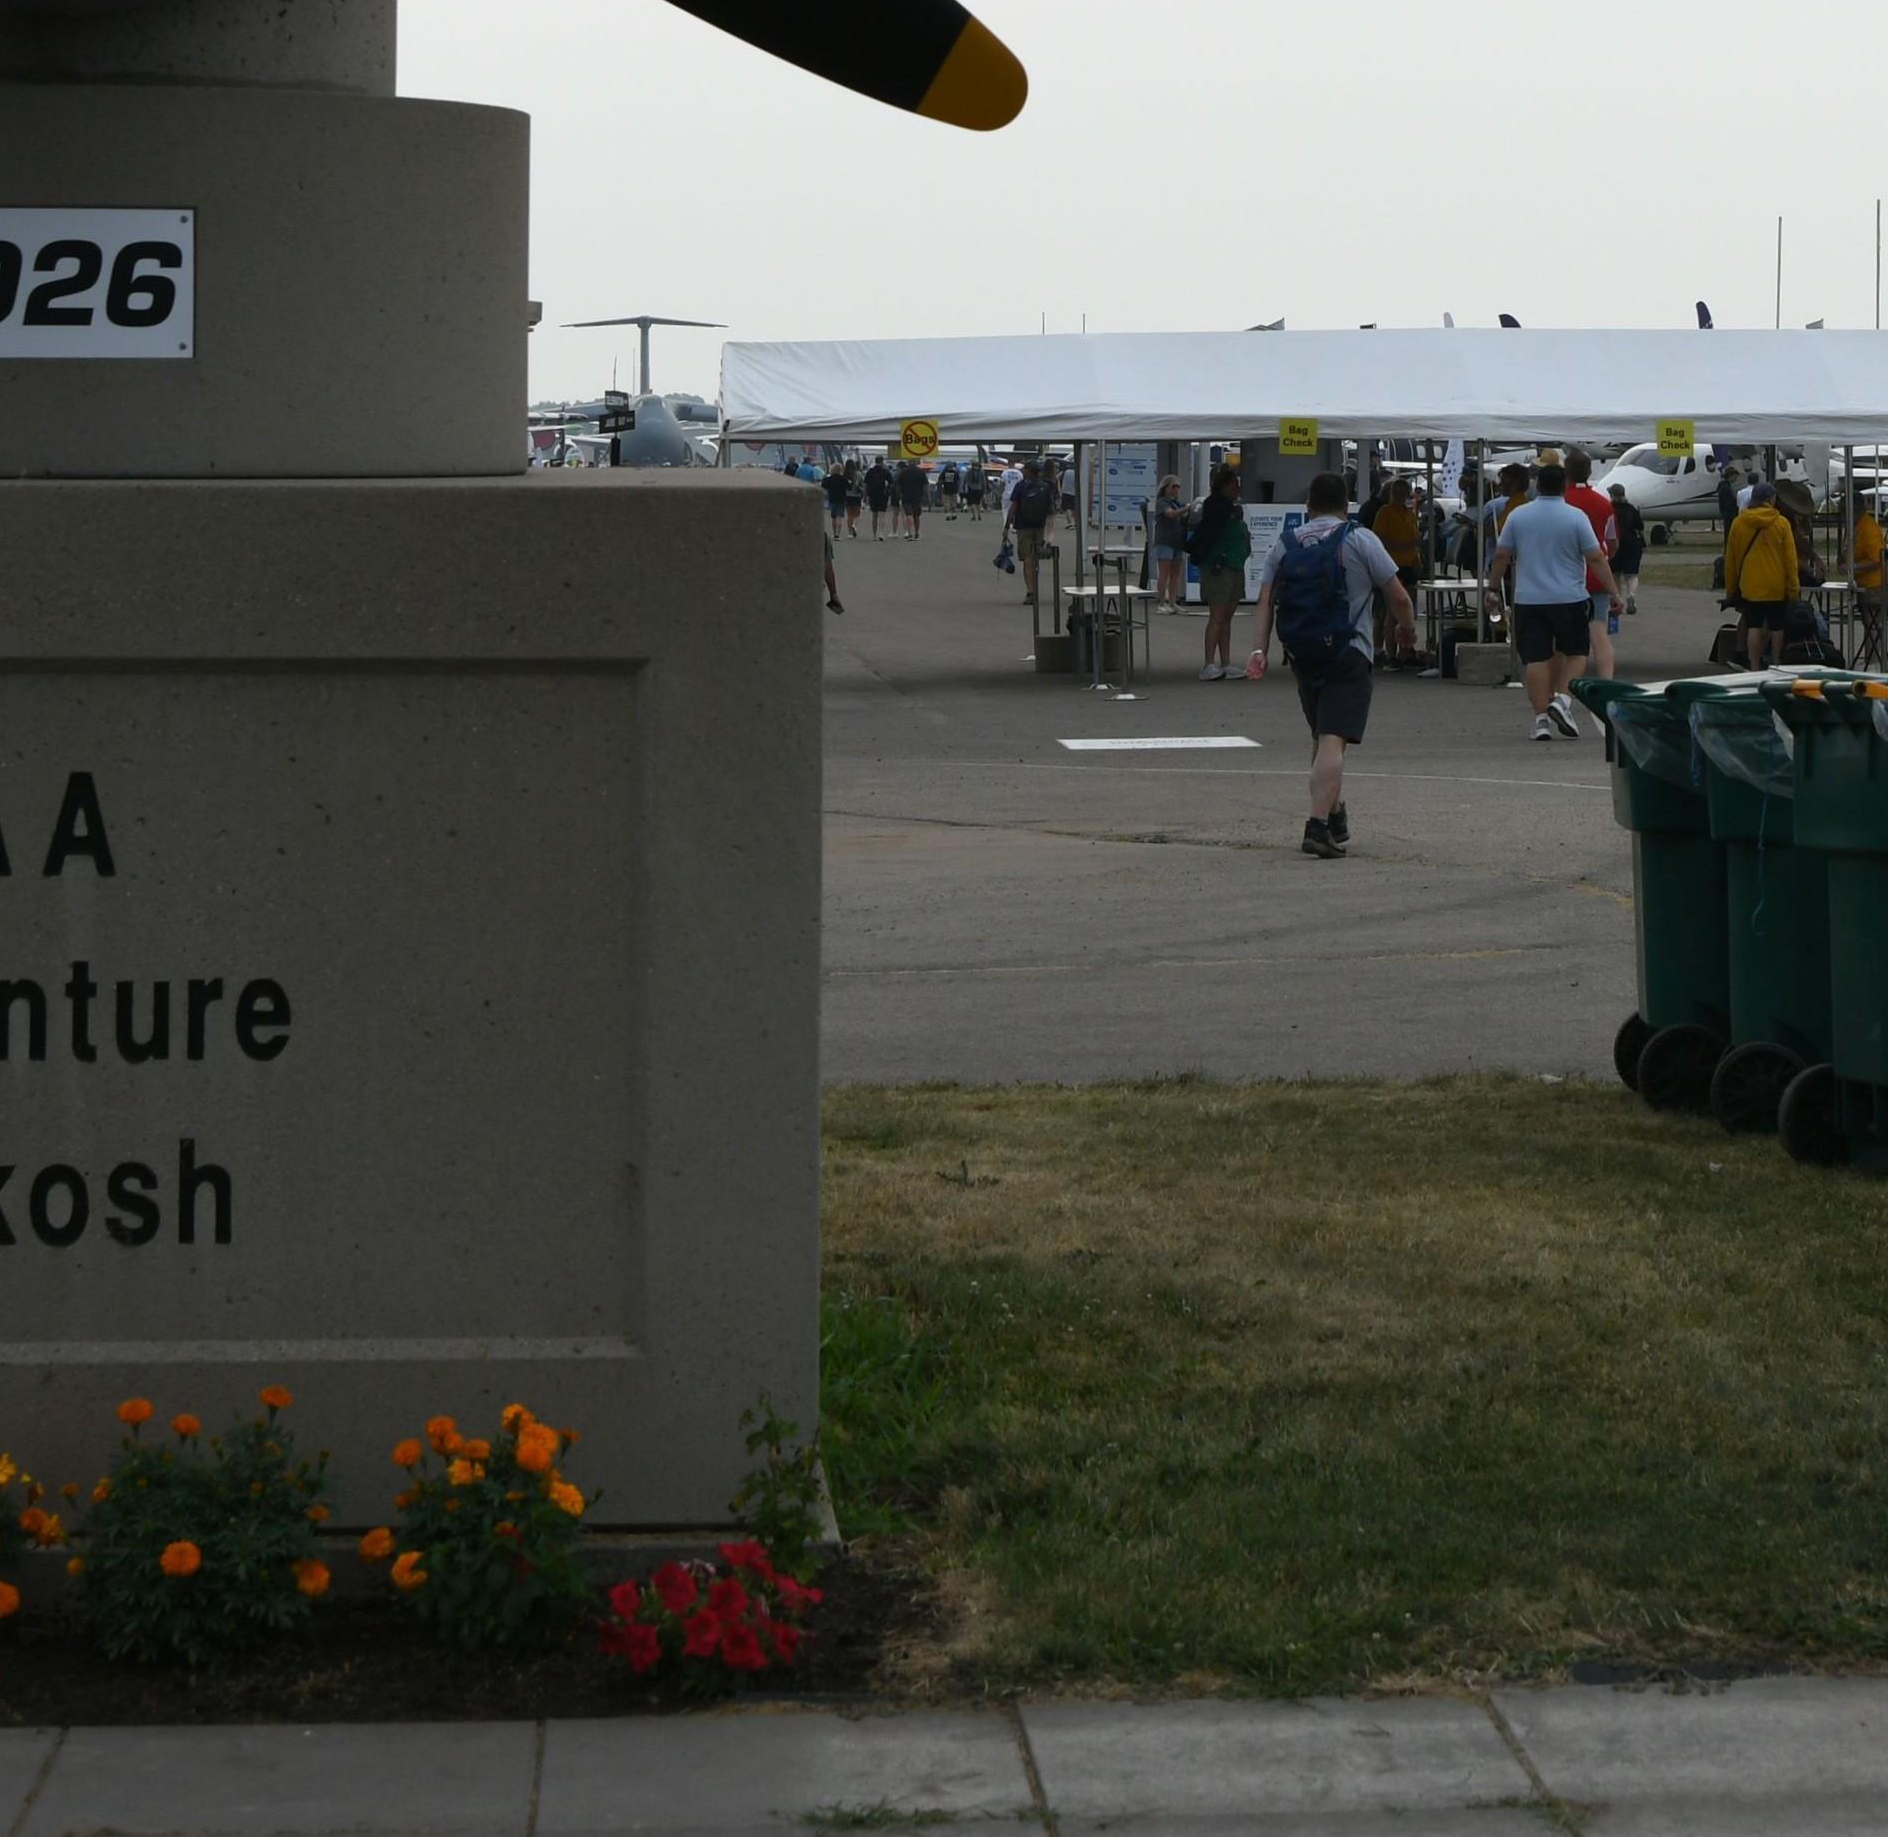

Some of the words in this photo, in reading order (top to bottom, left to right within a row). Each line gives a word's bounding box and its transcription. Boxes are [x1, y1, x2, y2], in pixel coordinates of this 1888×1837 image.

[1288, 425, 1309, 437] Bag
[1665, 427, 1685, 439] Bag
[905, 433, 935, 447] Bags
[1282, 438, 1313, 447] Check
[1660, 440, 1690, 450] Check
